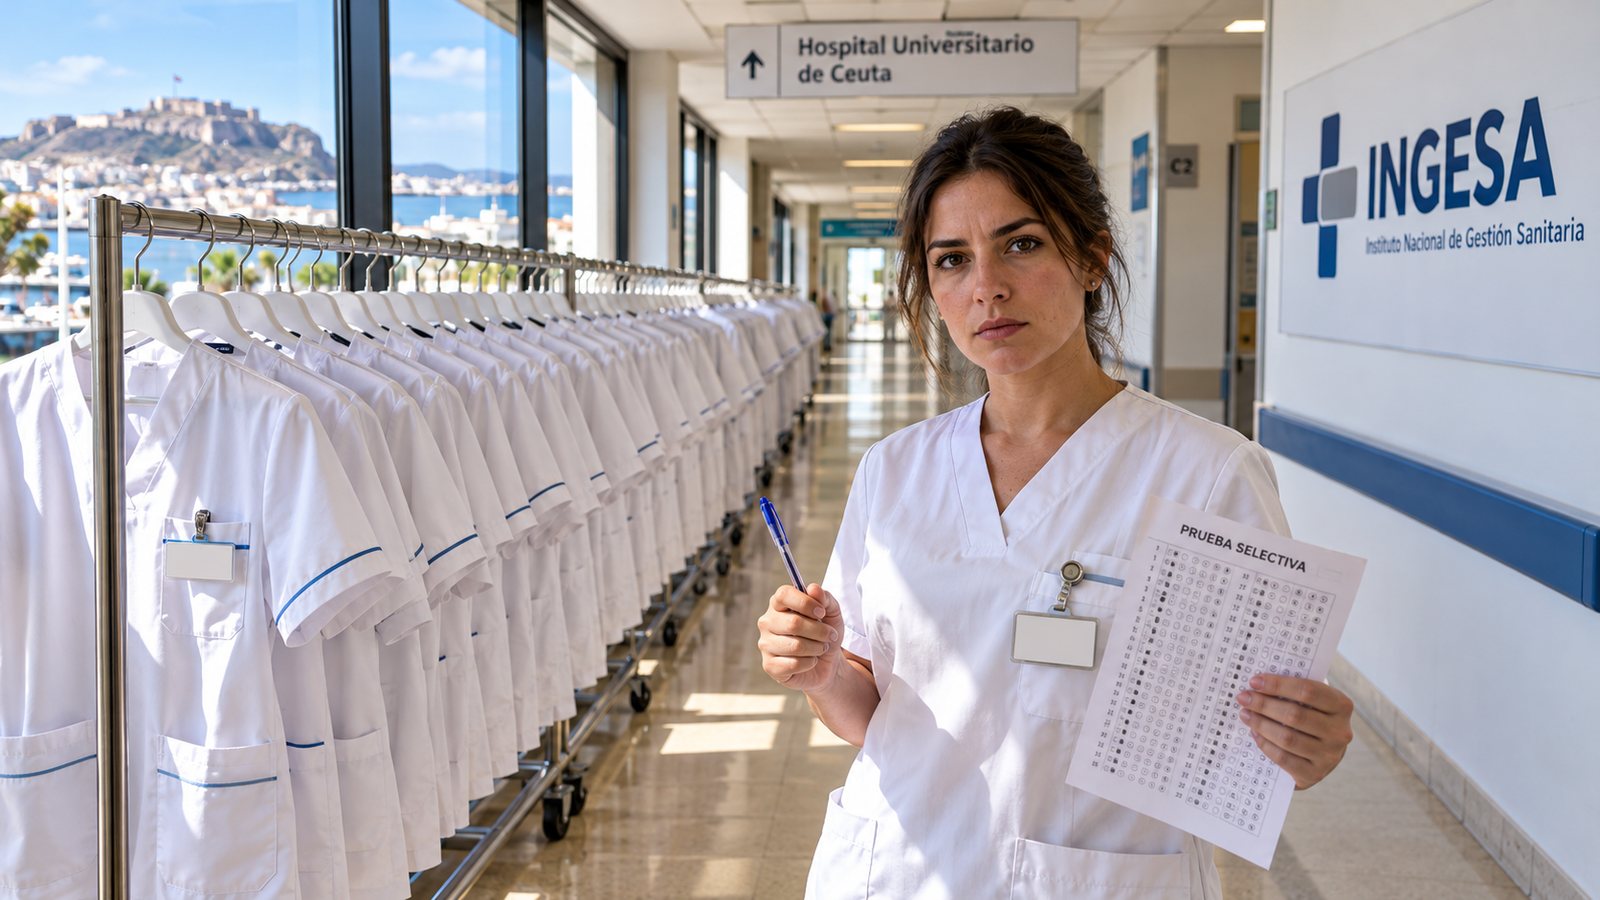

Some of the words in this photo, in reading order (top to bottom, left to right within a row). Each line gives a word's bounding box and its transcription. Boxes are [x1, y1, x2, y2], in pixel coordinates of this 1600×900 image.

[798, 35, 887, 60] Hospital
[892, 34, 1035, 55] Universitario
[798, 64, 825, 84] de
[830, 64, 893, 84] Ceuta
[1169, 157, 1194, 175] C2
[1368, 96, 1557, 220] INGESA
[1366, 235, 1402, 255] Instituto
[1403, 230, 1446, 252] Nacional
[1448, 228, 1463, 250] de
[1465, 224, 1513, 248] Gestión
[1517, 217, 1585, 246] Sanitaria
[1180, 523, 1232, 550] PRUEBA
[1236, 541, 1306, 573] SELECTIVA
